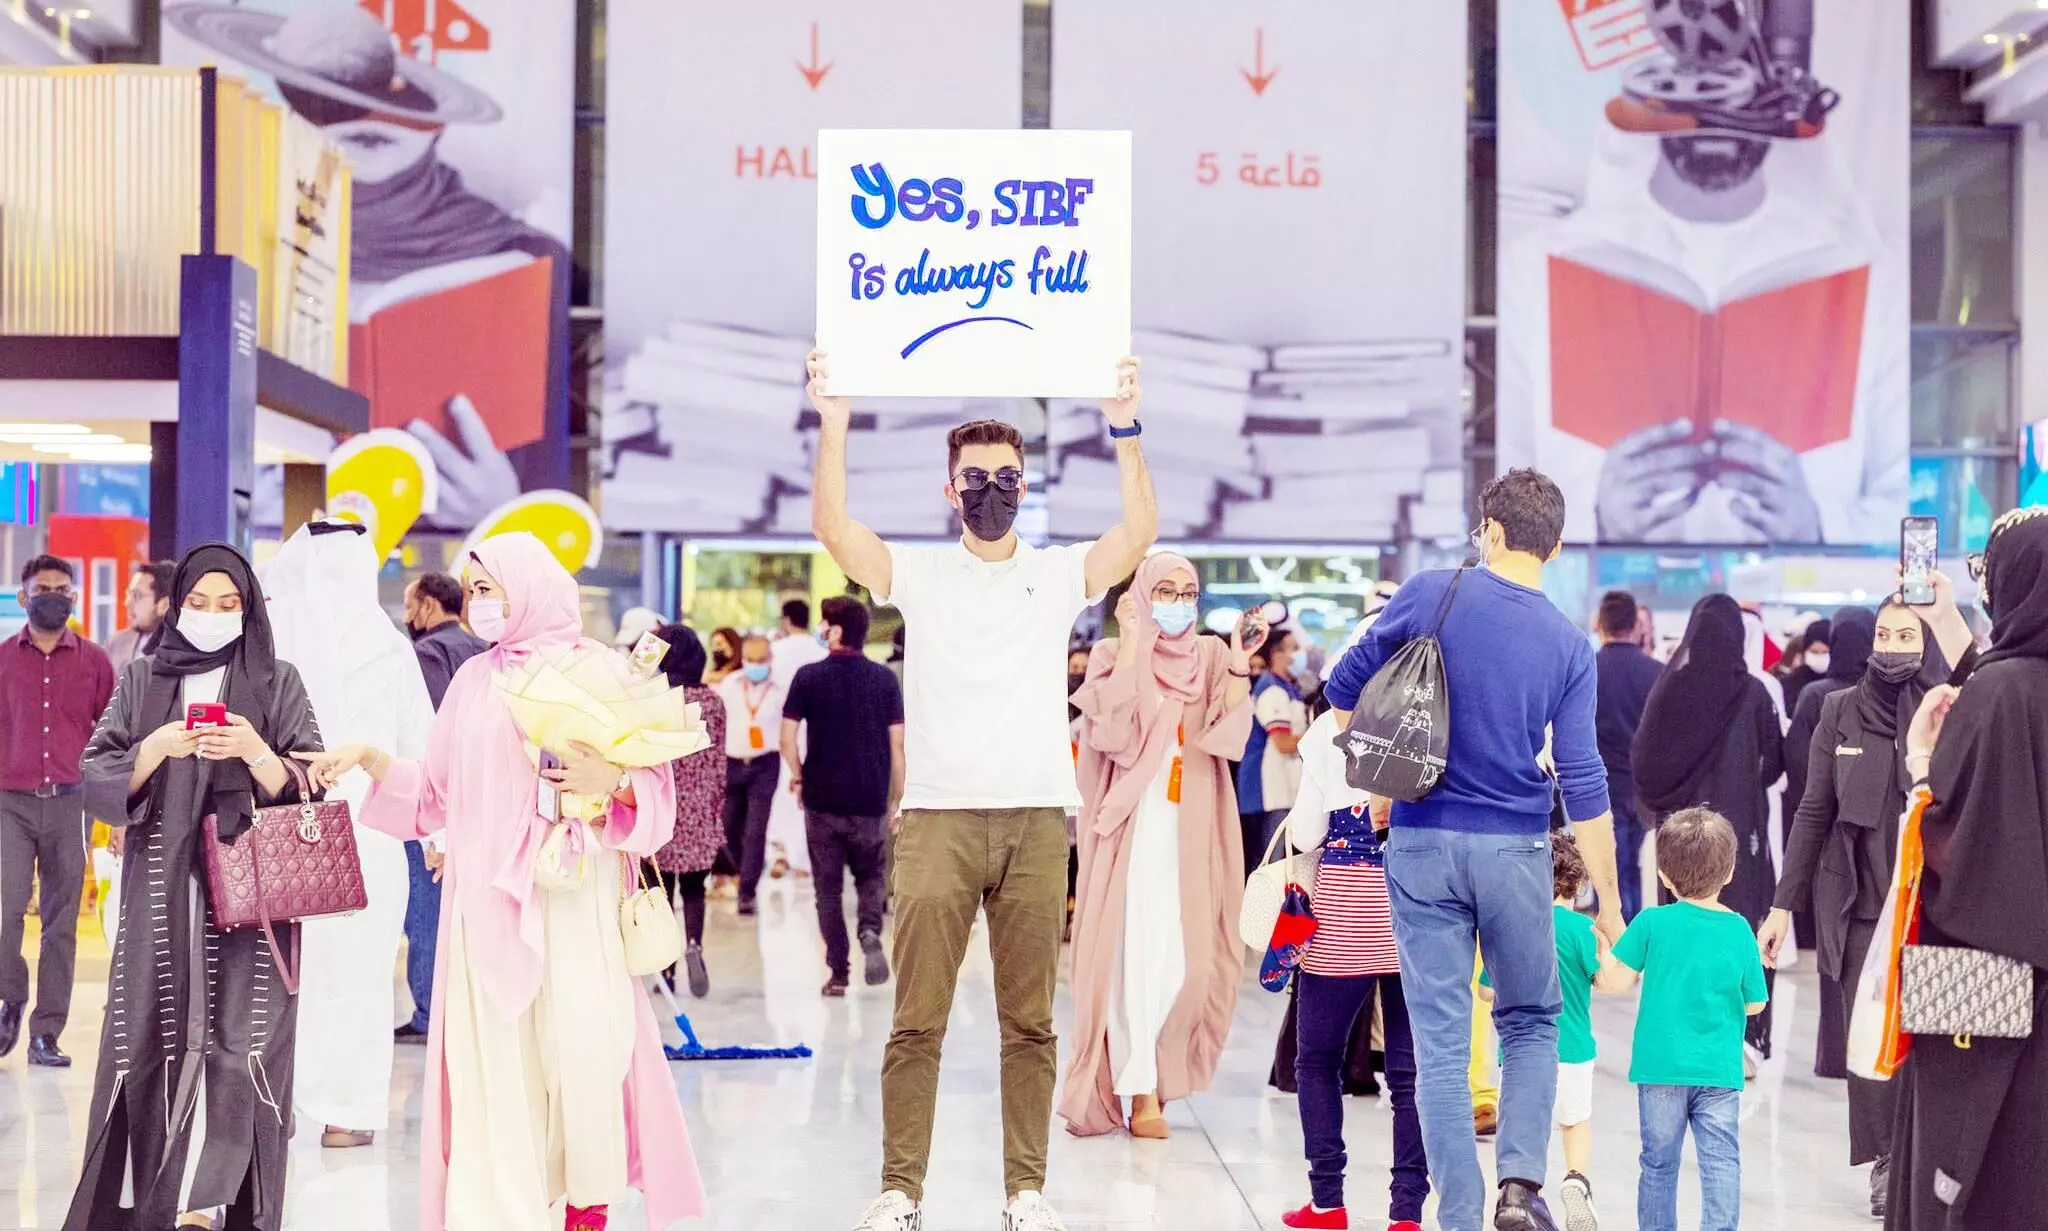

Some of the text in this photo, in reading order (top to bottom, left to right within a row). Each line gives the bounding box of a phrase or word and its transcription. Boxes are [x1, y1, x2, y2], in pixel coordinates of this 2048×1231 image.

[850, 162, 1093, 230] Yes, SIBF
[1196, 151, 1322, 188] قاعة 5
[849, 245, 1089, 309] is always full
